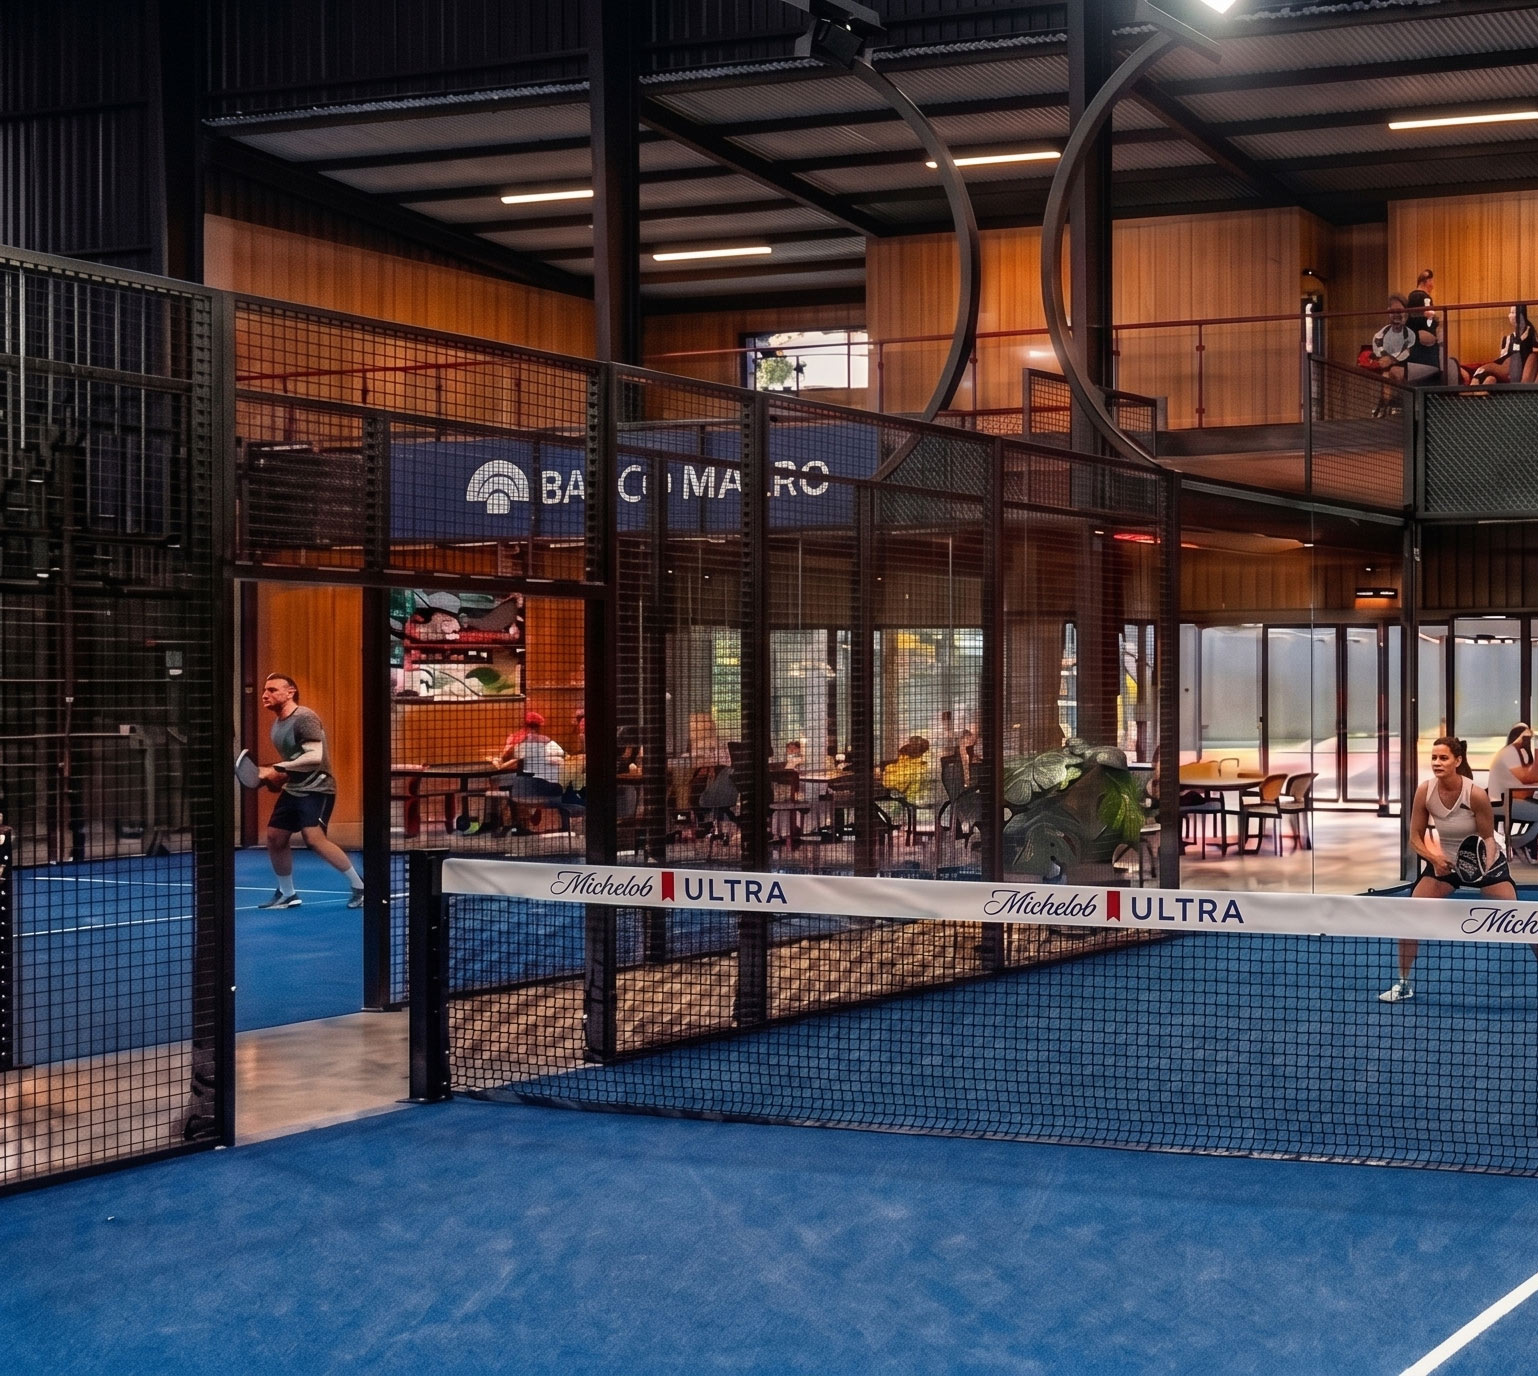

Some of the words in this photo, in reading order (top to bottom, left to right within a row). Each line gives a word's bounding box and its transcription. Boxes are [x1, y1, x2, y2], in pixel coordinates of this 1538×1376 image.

[541, 464, 671, 504] BAC
[683, 460, 830, 500] MARO
[551, 871, 653, 897] Michelob
[685, 878, 787, 904] ULTRA
[984, 890, 1097, 917] Michelob
[1132, 897, 1244, 923] ULTRA
